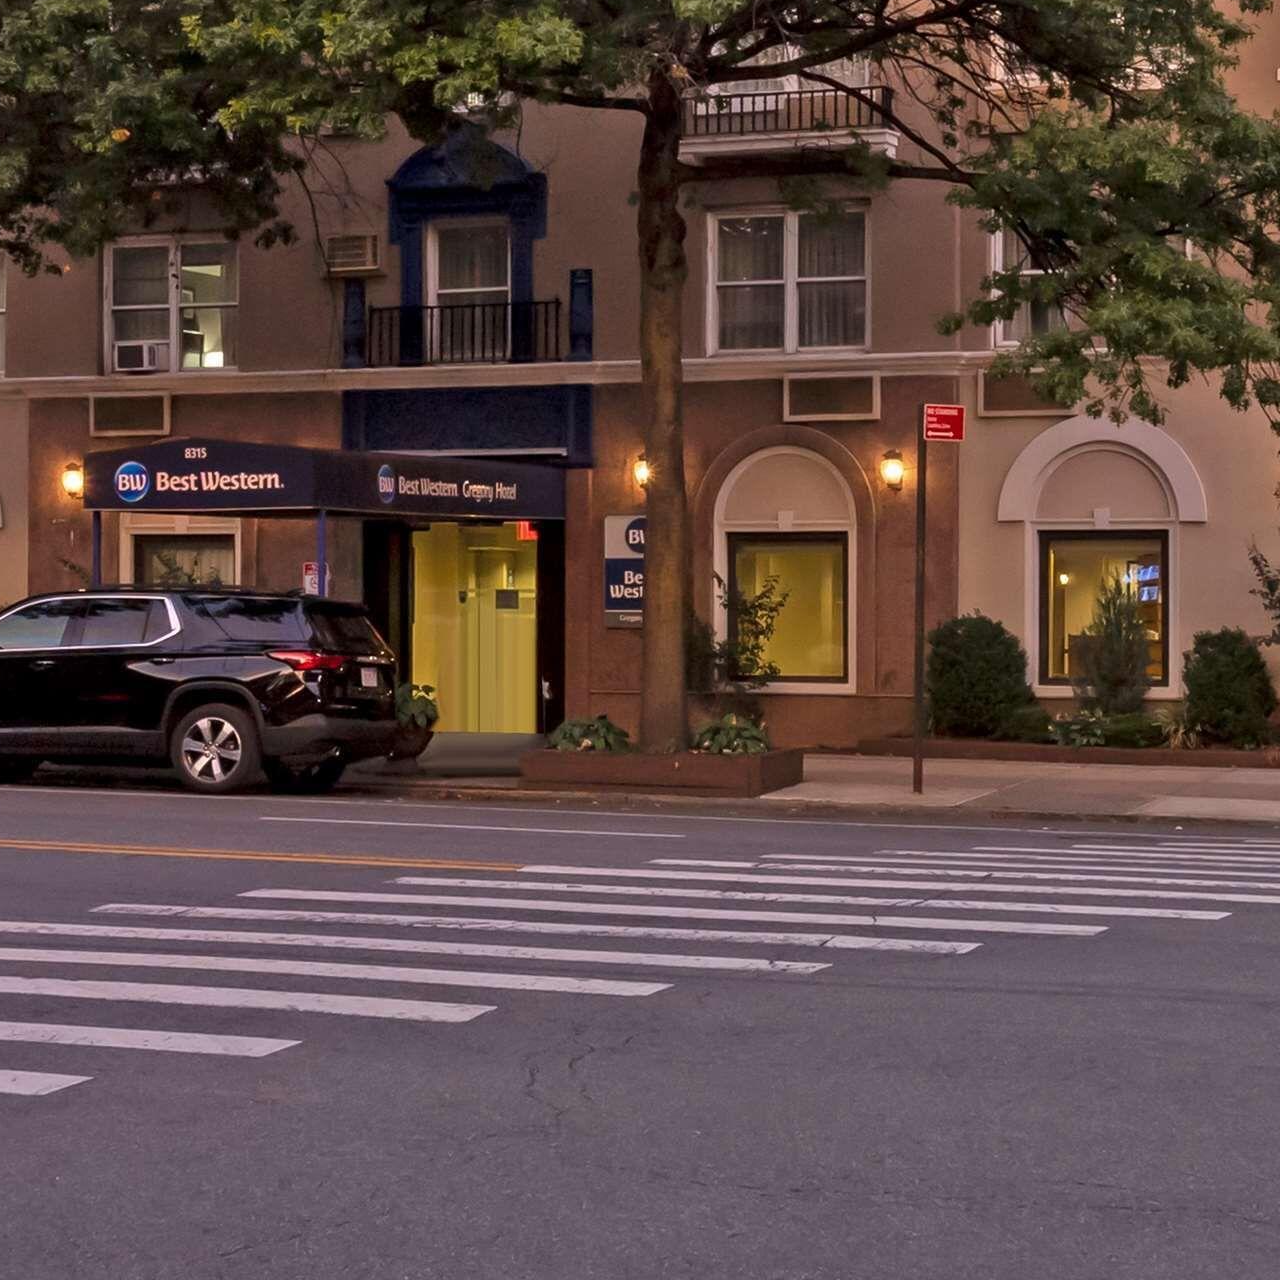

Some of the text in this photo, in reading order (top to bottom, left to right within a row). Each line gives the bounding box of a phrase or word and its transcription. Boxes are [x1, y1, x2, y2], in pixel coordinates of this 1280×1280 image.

[184, 447, 208, 459] 8315
[118, 473, 147, 491] BW
[156, 472, 198, 491] Best
[378, 476, 395, 493] BW
[398, 476, 420, 495] Best
[462, 480, 494, 503] Gregory
[495, 482, 517, 500] Hotel
[624, 570, 644, 585] Be
